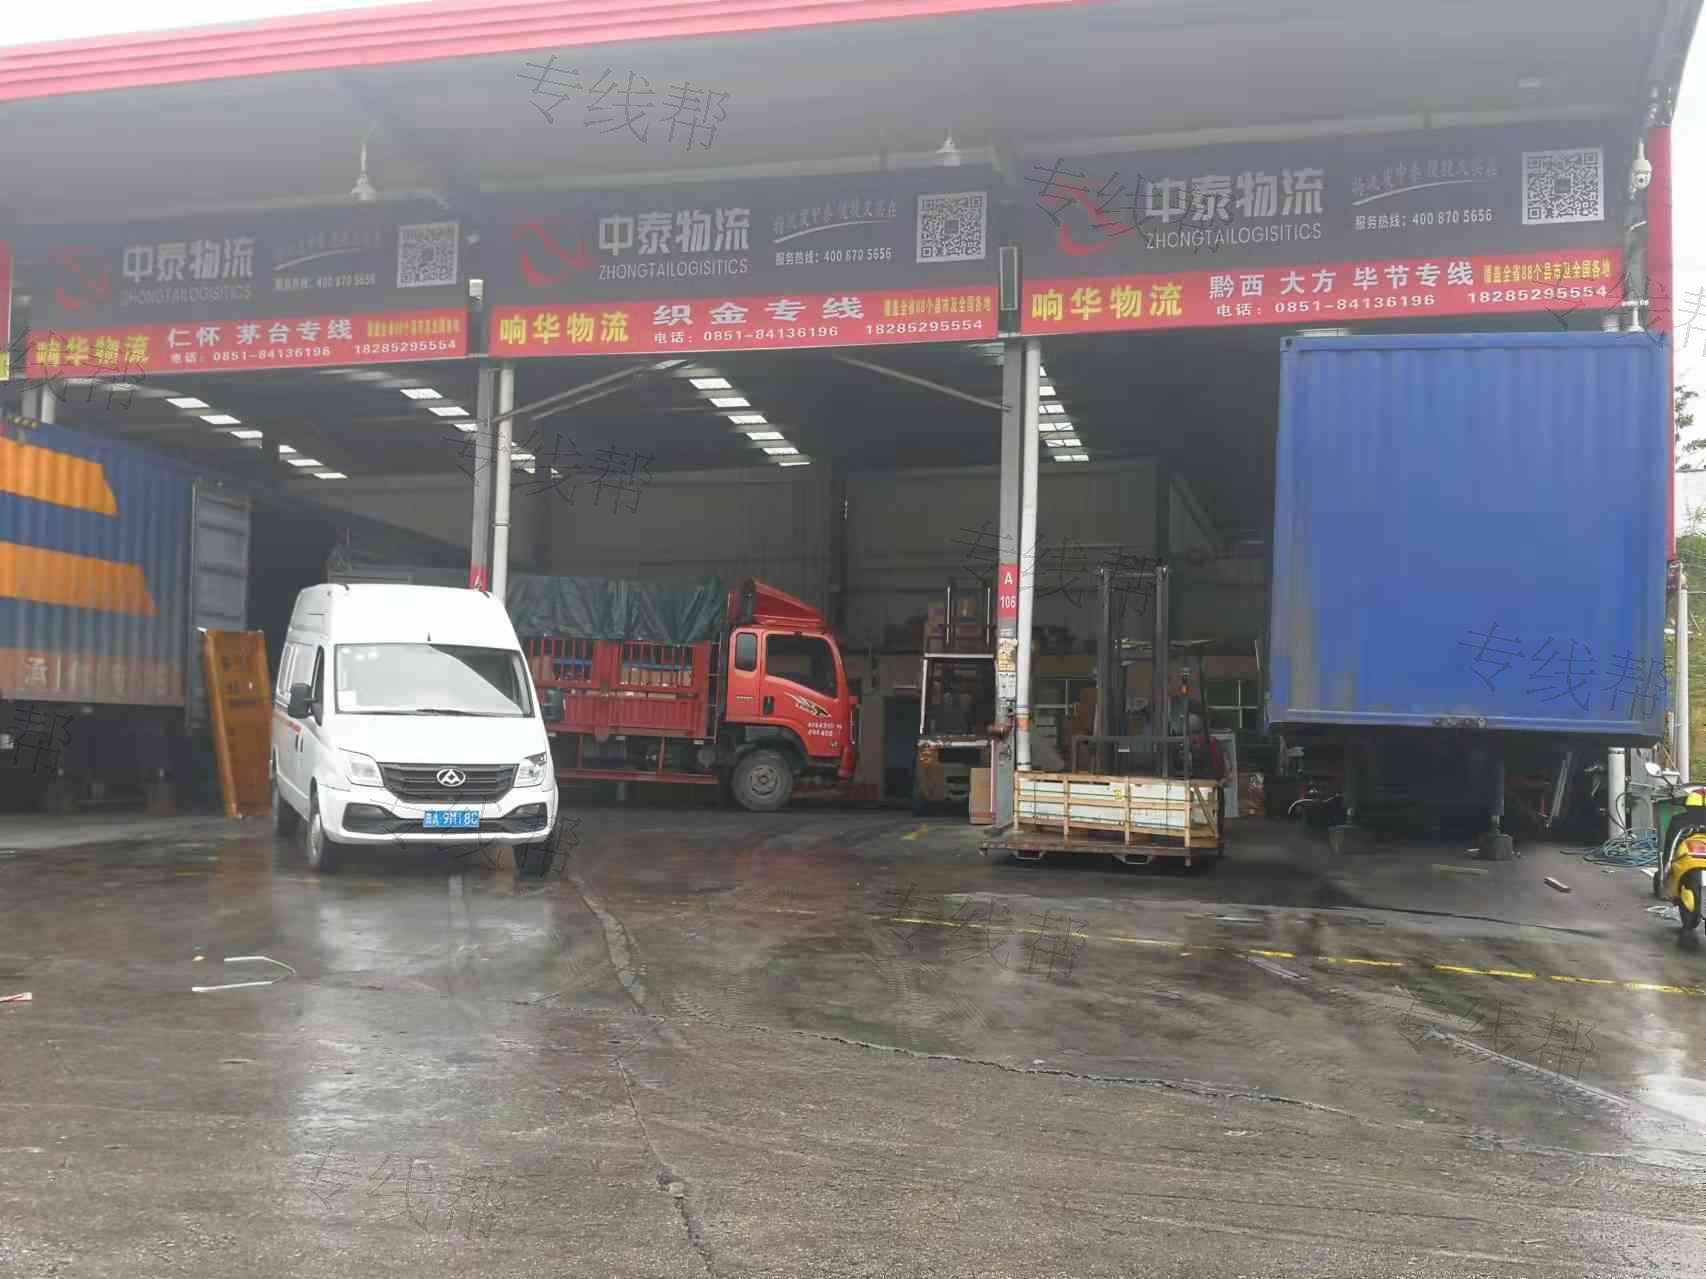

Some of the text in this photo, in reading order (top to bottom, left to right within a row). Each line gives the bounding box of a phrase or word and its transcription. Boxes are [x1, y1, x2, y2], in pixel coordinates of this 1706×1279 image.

[1144, 167, 1324, 223] 中泰物流
[598, 207, 750, 257] 中泰物流
[1412, 212, 1434, 226] 400
[1438, 210, 1460, 225] 870
[1463, 208, 1493, 223] 5656
[1144, 222, 1322, 250] ZHONGTAILOGISITICS
[122, 236, 256, 283] 中泰物流
[598, 257, 750, 282] ZHONGTAILOGISITICS
[823, 249, 843, 263] 400
[1208, 260, 1476, 299] 黔西 大方 毕节专线
[653, 298, 866, 328] 织金专线
[1030, 282, 1183, 321] 响华物流
[1274, 293, 1437, 314] 0851-84136196
[1467, 285, 1608, 305] 18285295554
[167, 327, 221, 349] 仁怀
[237, 318, 354, 345] 茅台专线
[499, 311, 630, 345] 响华物流
[703, 325, 839, 342] 0851-84136196
[865, 319, 983, 336] 18285295554
[34, 335, 151, 369] 响华物流
[212, 346, 332, 363] 0851-84136196
[354, 339, 457, 356] 18285295554
[1004, 571, 1013, 584] A
